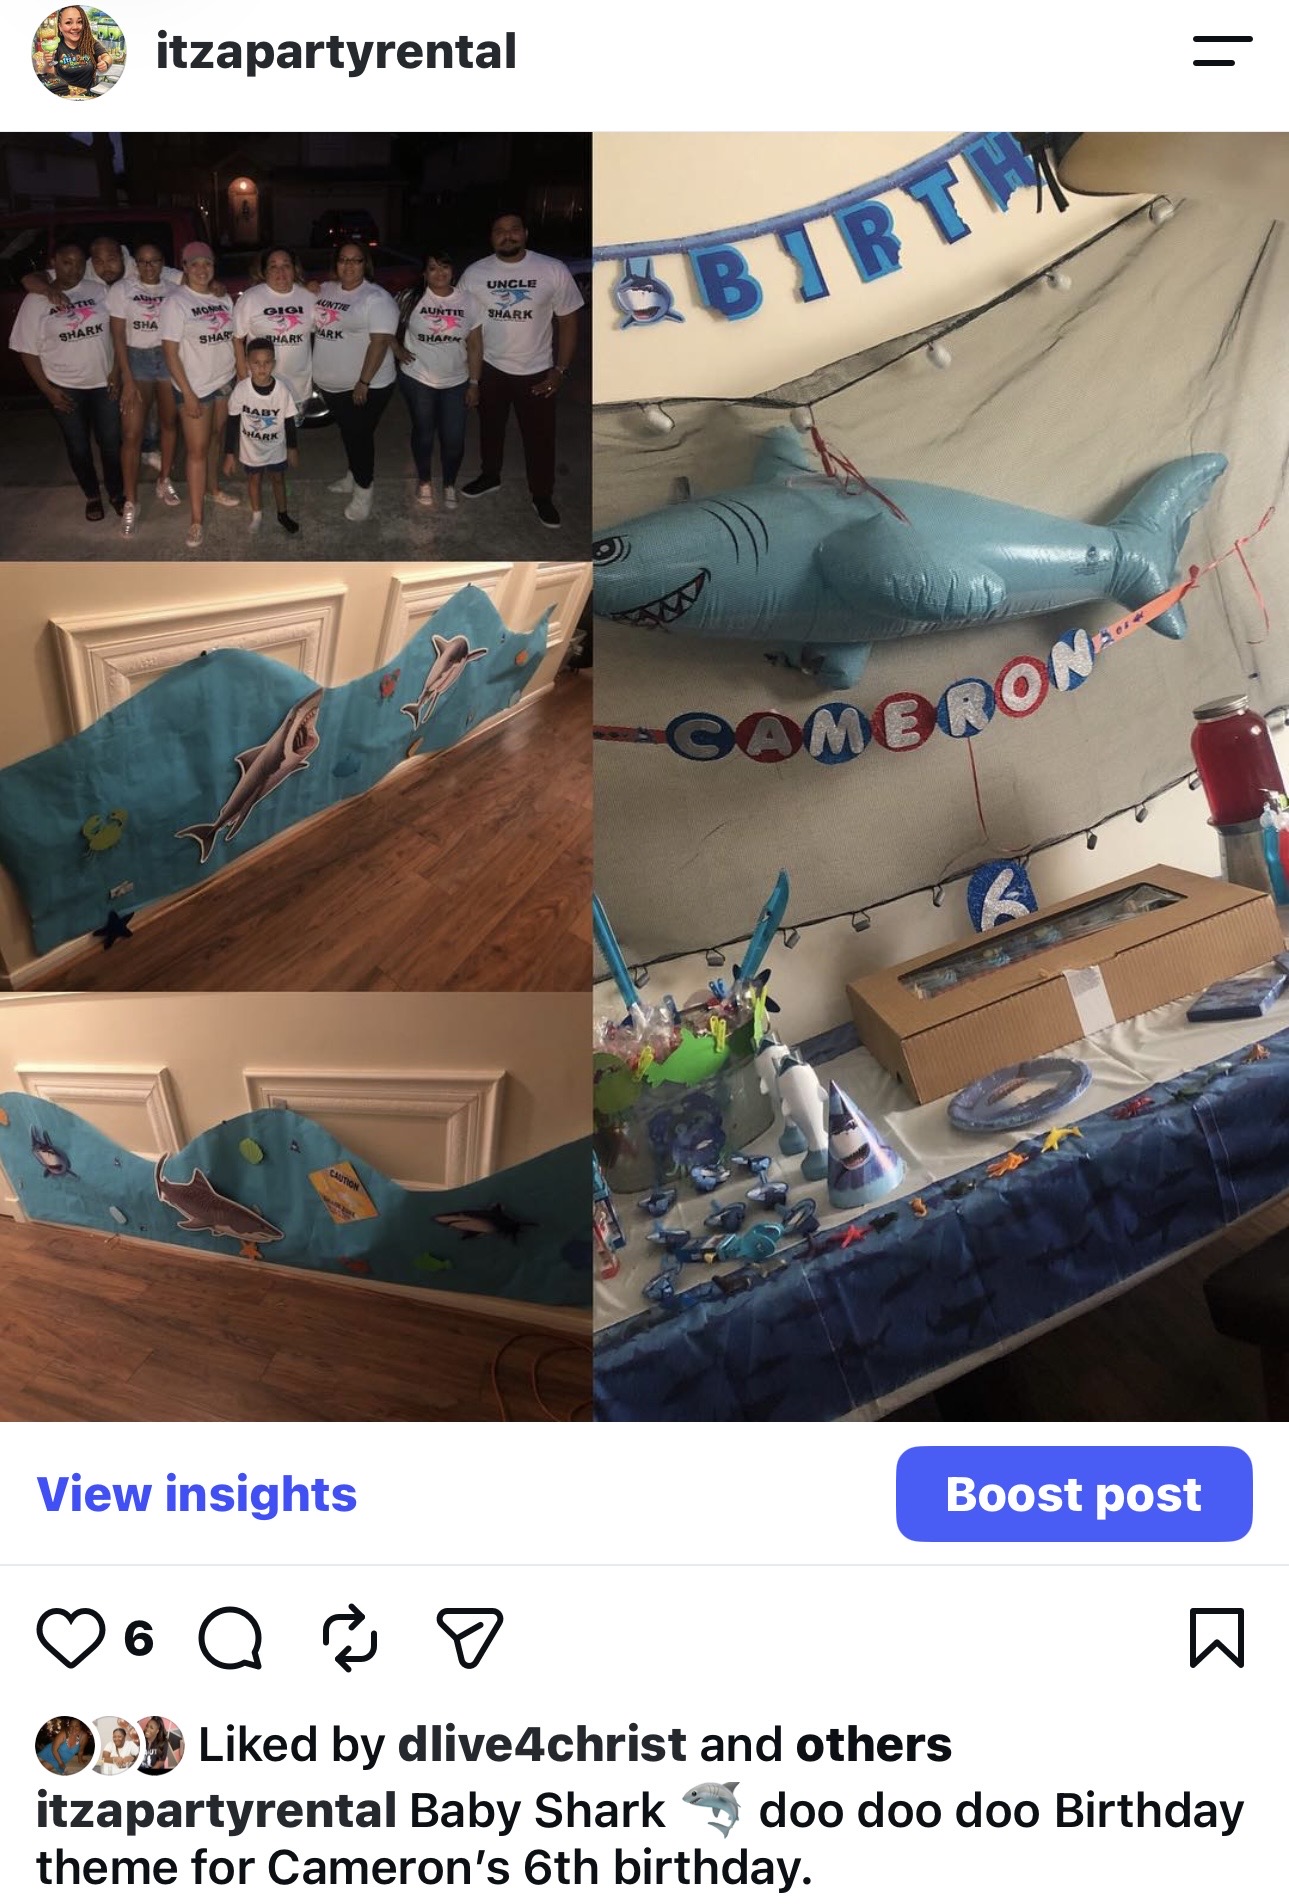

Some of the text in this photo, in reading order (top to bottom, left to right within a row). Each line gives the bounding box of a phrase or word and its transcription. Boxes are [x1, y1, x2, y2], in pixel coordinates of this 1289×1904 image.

[157, 30, 516, 78] itzapartyrental
[688, 133, 1047, 321] BIRTH
[487, 279, 537, 289] UNCLE
[263, 306, 304, 316] GIGI
[419, 306, 465, 318] AUNTIE
[488, 309, 533, 319] SHARK
[58, 323, 104, 342] SHARK
[417, 333, 462, 343] SHARK
[242, 404, 281, 417] BABY
[674, 630, 1093, 758] CAMERON
[981, 868, 1030, 932] 6
[329, 1169, 359, 1191] CAUTION
[36, 1472, 357, 1521] View insights
[947, 1476, 1202, 1521] Boost post
[124, 1619, 154, 1657] 6
[200, 1722, 953, 1771] Liked by dlive4christ and others
[37, 1788, 1245, 1837] itzapartyrental Baby Shark doo doo doo Birthday
[35, 1846, 812, 1894] theme for Cameron’s 6th birthday.
